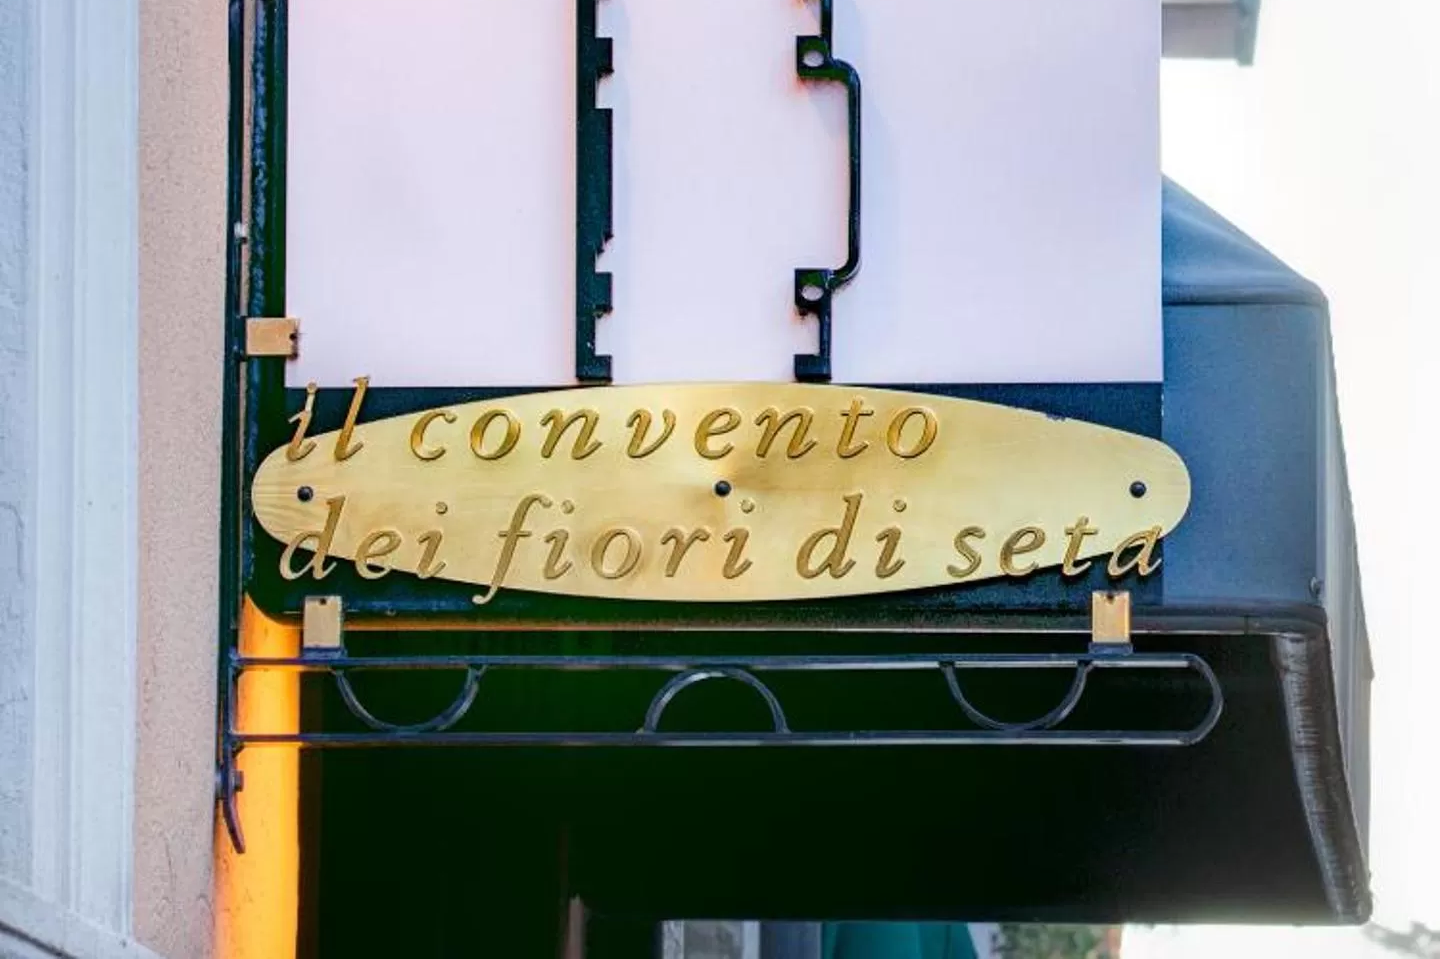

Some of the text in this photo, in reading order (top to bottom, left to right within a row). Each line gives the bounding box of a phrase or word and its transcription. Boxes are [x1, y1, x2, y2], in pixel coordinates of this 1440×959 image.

[285, 374, 939, 463] il convento
[278, 490, 1165, 605] dei fiori di seta
